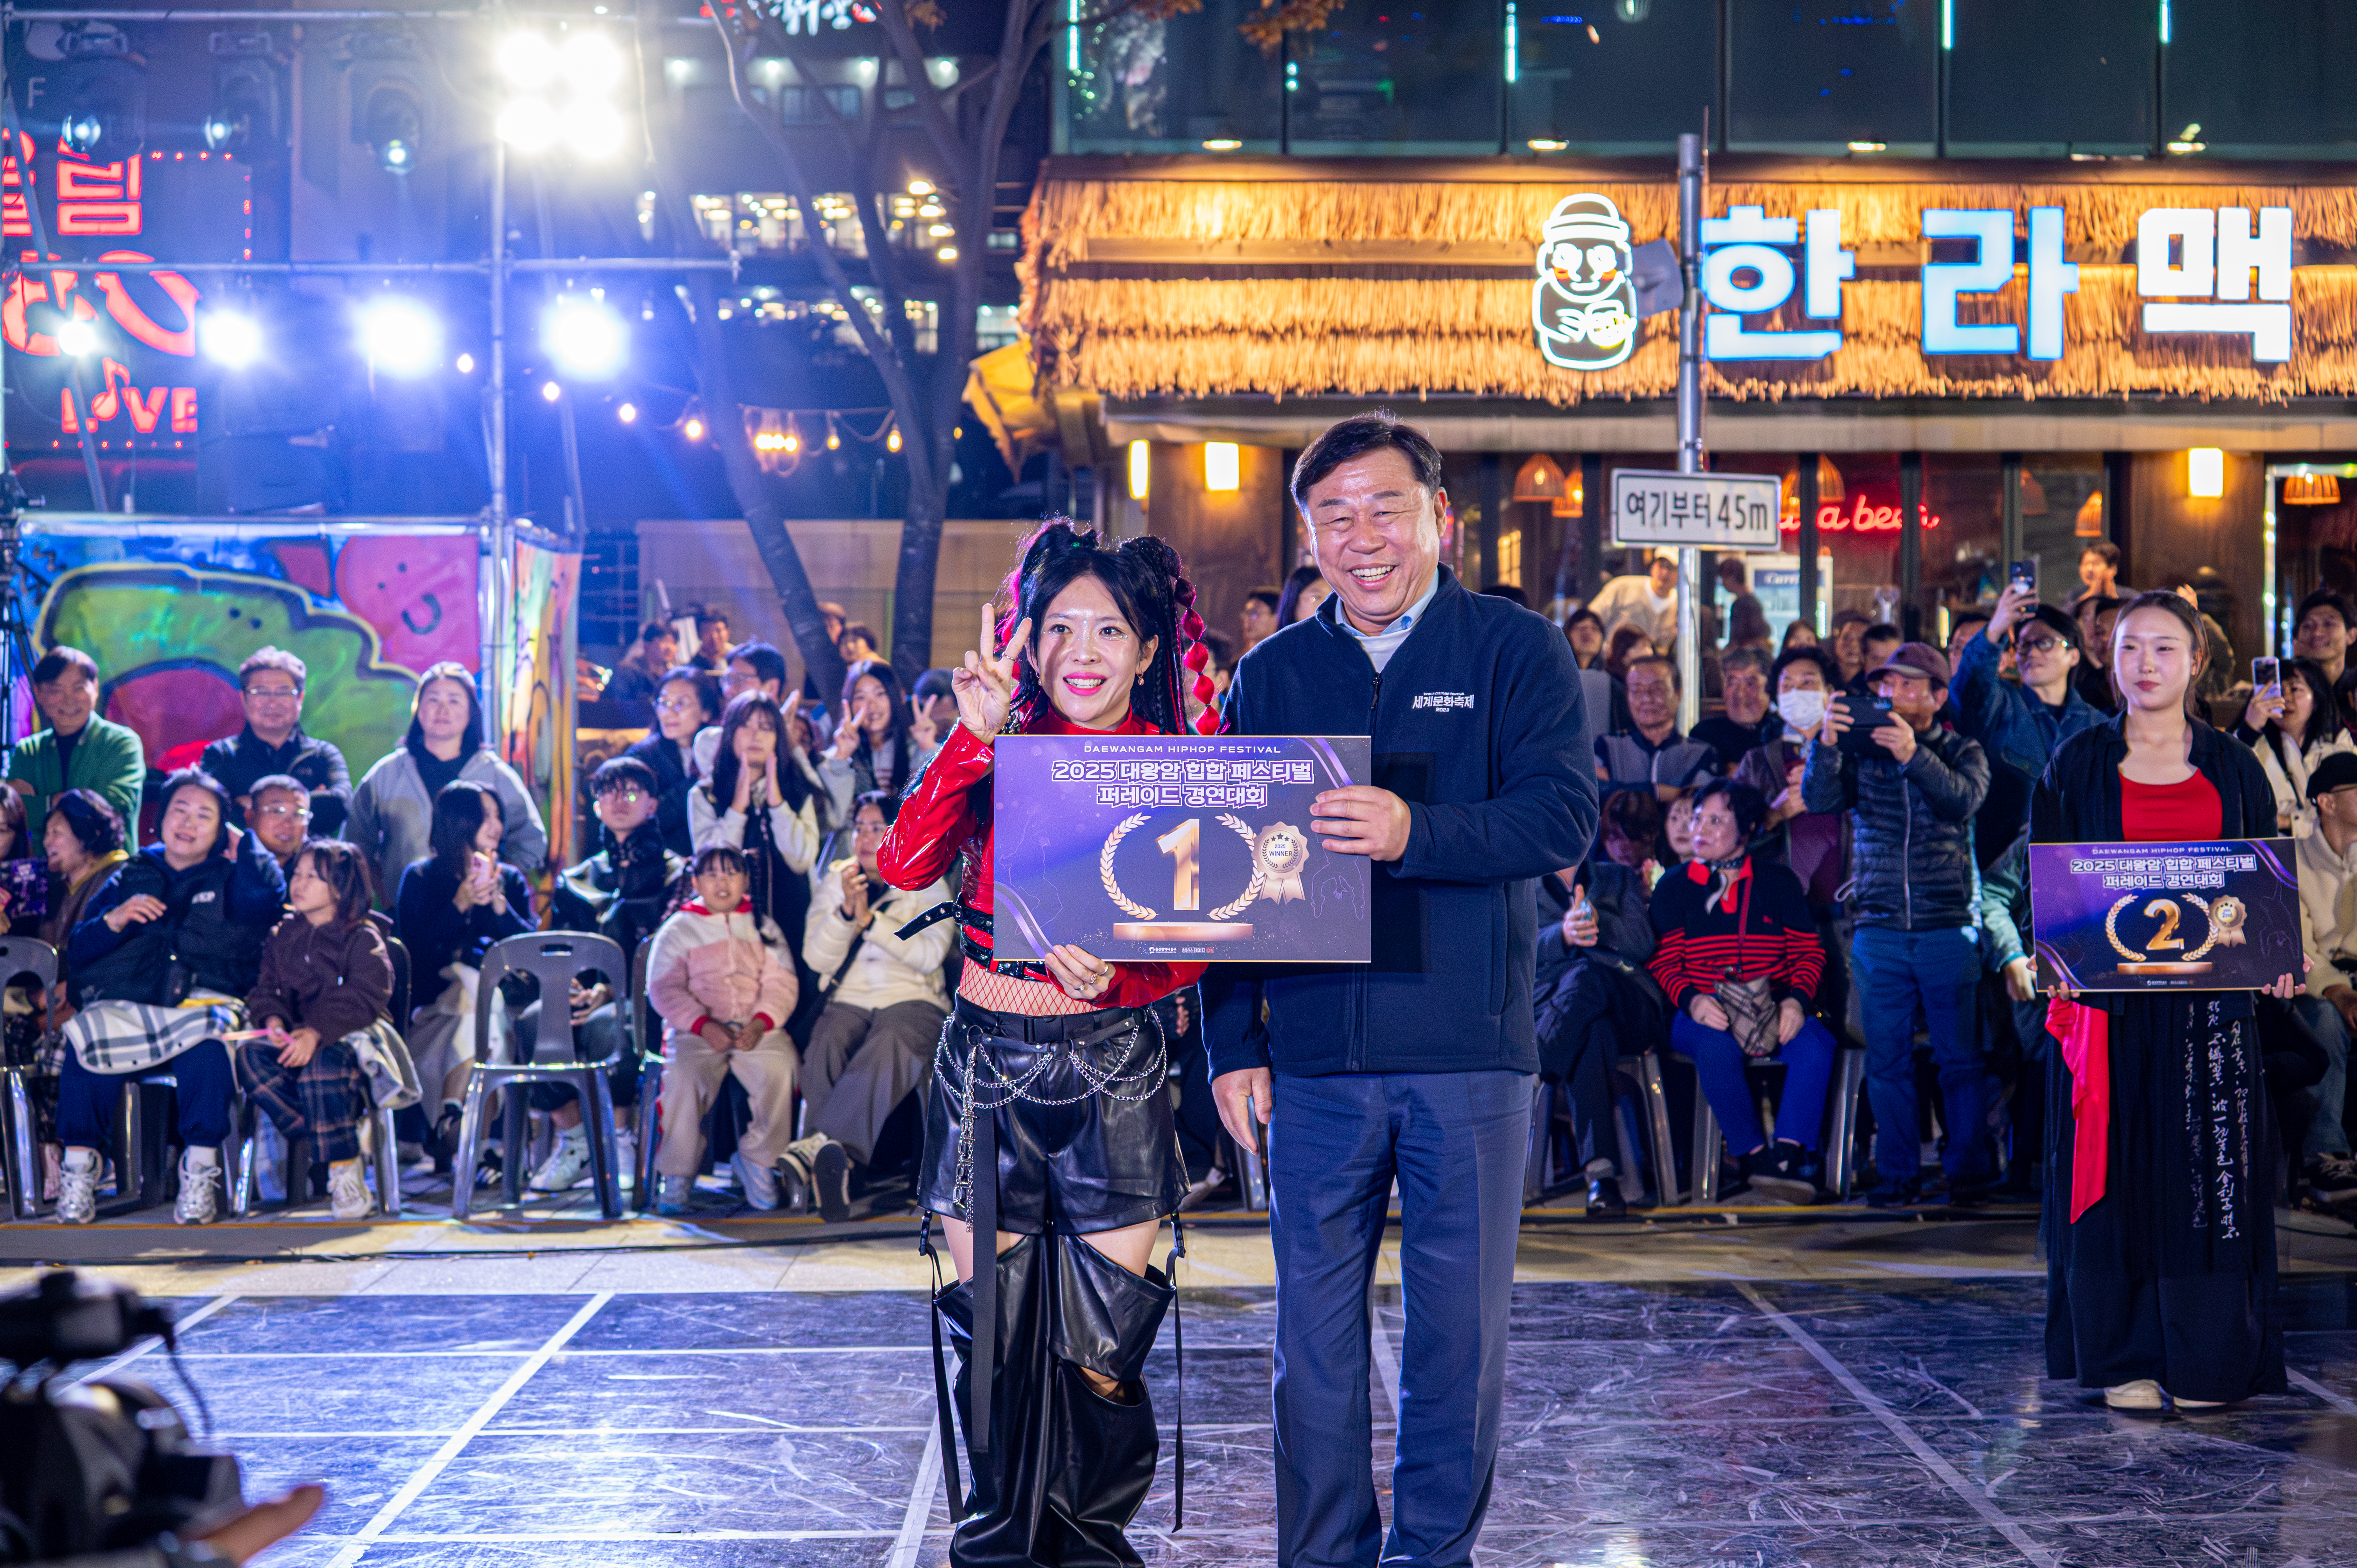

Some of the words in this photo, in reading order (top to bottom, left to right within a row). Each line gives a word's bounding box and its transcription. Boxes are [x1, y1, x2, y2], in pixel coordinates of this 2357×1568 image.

[1701, 206, 2292, 362] 한라맥
[1627, 490, 1711, 529] 여기부터
[1717, 494, 1768, 530] 45m
[1412, 694, 1474, 709] 세계문화축제
[1054, 762, 1116, 780] 2025
[1120, 761, 1181, 781] 대왕암
[1185, 761, 1227, 781] 힙합
[1230, 761, 1312, 781] 페스티벌
[1099, 786, 1180, 805] 퍼레이드
[1185, 786, 1266, 805] 경연대회
[1155, 818, 1200, 911] 1
[2072, 860, 2117, 872] 2025
[2118, 858, 2162, 872] 대왕암
[2164, 857, 2194, 871] 힙합
[2196, 856, 2255, 870] 페스티벌
[2104, 874, 2163, 888] 퍼레이드
[2165, 872, 2223, 887] 경연대회
[2144, 899, 2184, 951] 2
